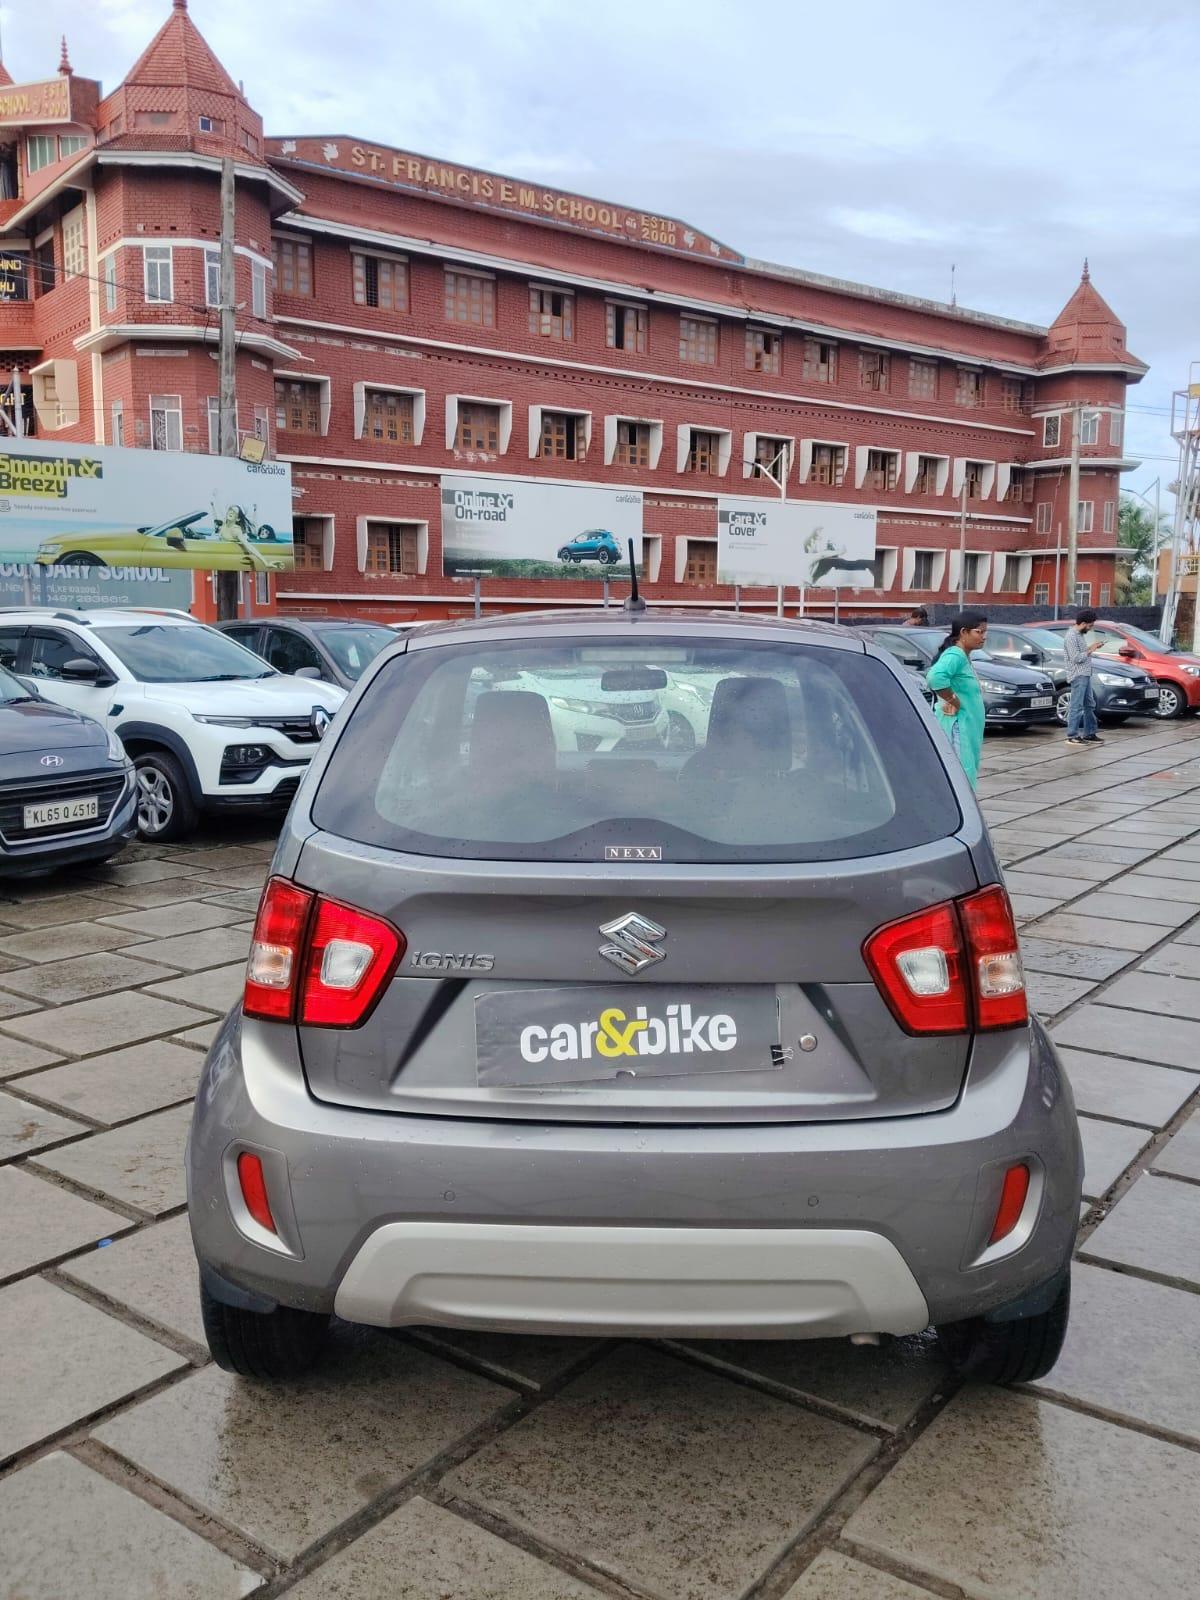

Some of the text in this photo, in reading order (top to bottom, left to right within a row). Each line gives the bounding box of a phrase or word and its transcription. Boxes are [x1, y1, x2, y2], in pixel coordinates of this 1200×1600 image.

[351, 146, 385, 171] ST.
[392, 156, 494, 198] FRANCIS
[542, 193, 622, 229] SCHOOL
[641, 214, 676, 233] ESTD
[641, 227, 676, 246] 2000
[0, 454, 102, 478] Smooth &
[0, 472, 68, 498] Breezy
[454, 490, 494, 508] Online
[455, 504, 507, 522] On-road
[728, 511, 751, 525] Care
[728, 523, 757, 537] Cover
[72, 802, 96, 817] 4518
[609, 847, 658, 859] NEXA
[410, 950, 497, 972] IGNIS
[519, 1003, 738, 1064] car&bike
